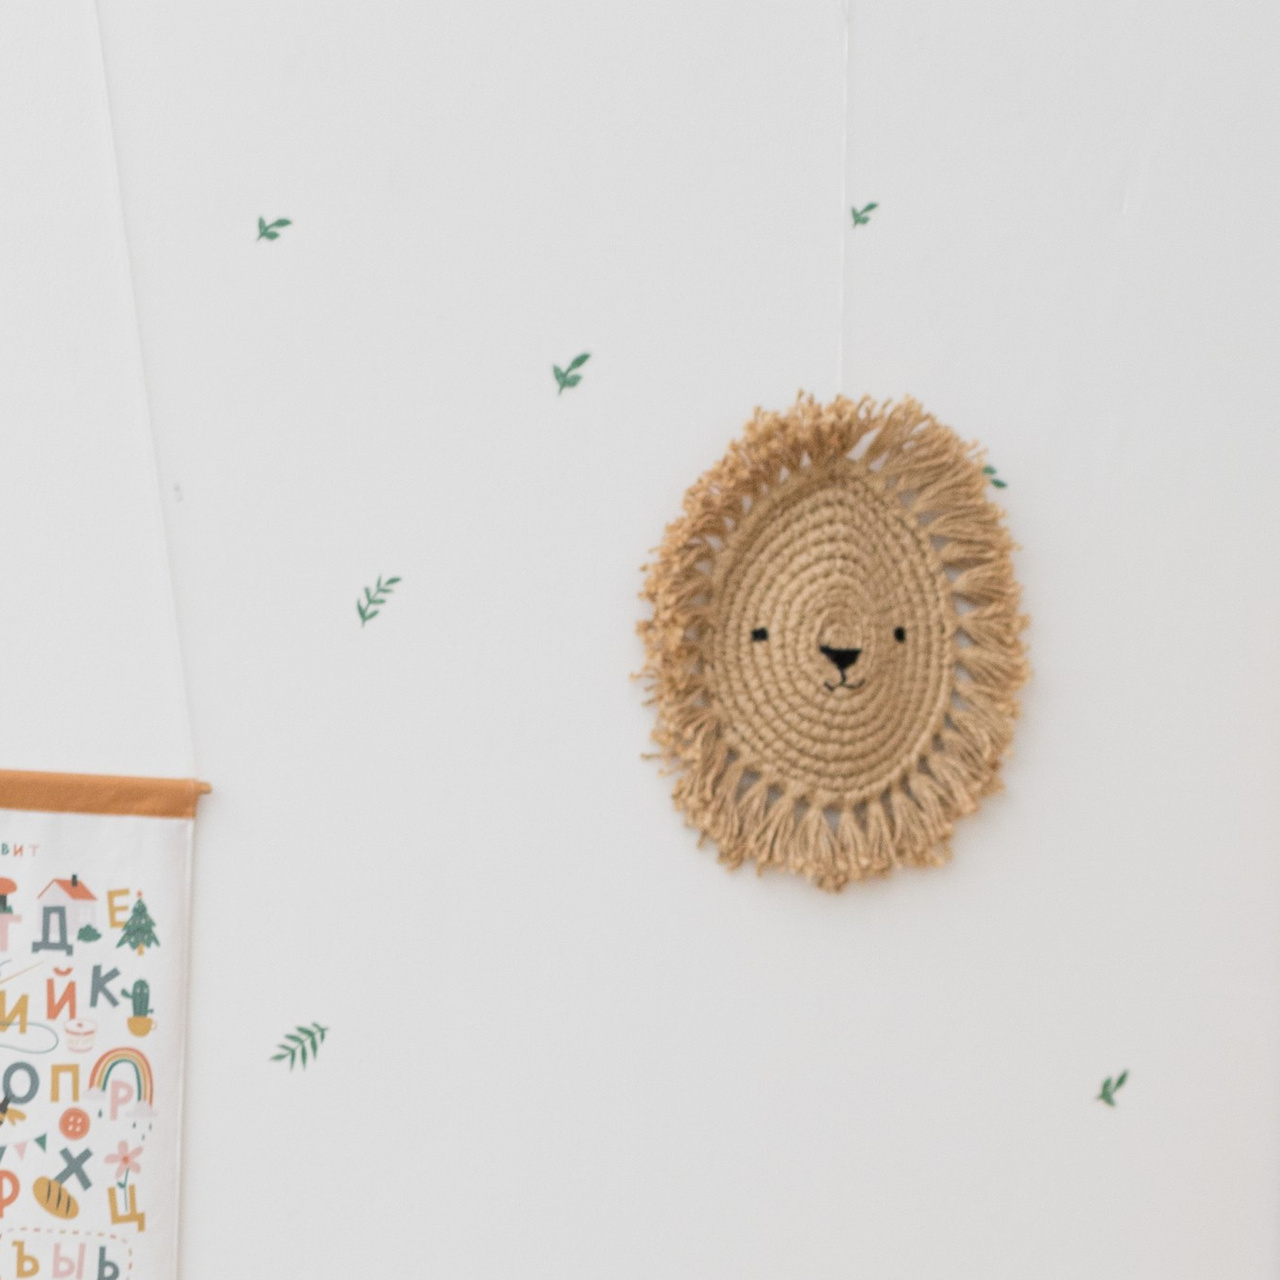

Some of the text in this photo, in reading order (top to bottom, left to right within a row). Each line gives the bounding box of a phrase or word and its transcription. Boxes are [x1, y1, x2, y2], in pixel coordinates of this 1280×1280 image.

[31, 906, 74, 956] Д
[107, 888, 131, 928] Е
[46, 966, 77, 1021] Й
[89, 964, 121, 1008] К
[2, 1061, 40, 1105] О
[50, 1064, 79, 1103] П
[109, 1080, 134, 1121] Р
[53, 1147, 94, 1191] Х
[107, 1184, 146, 1232] Ц
[12, 1240, 40, 1279] Ъ
[52, 1242, 86, 1280] Ы
